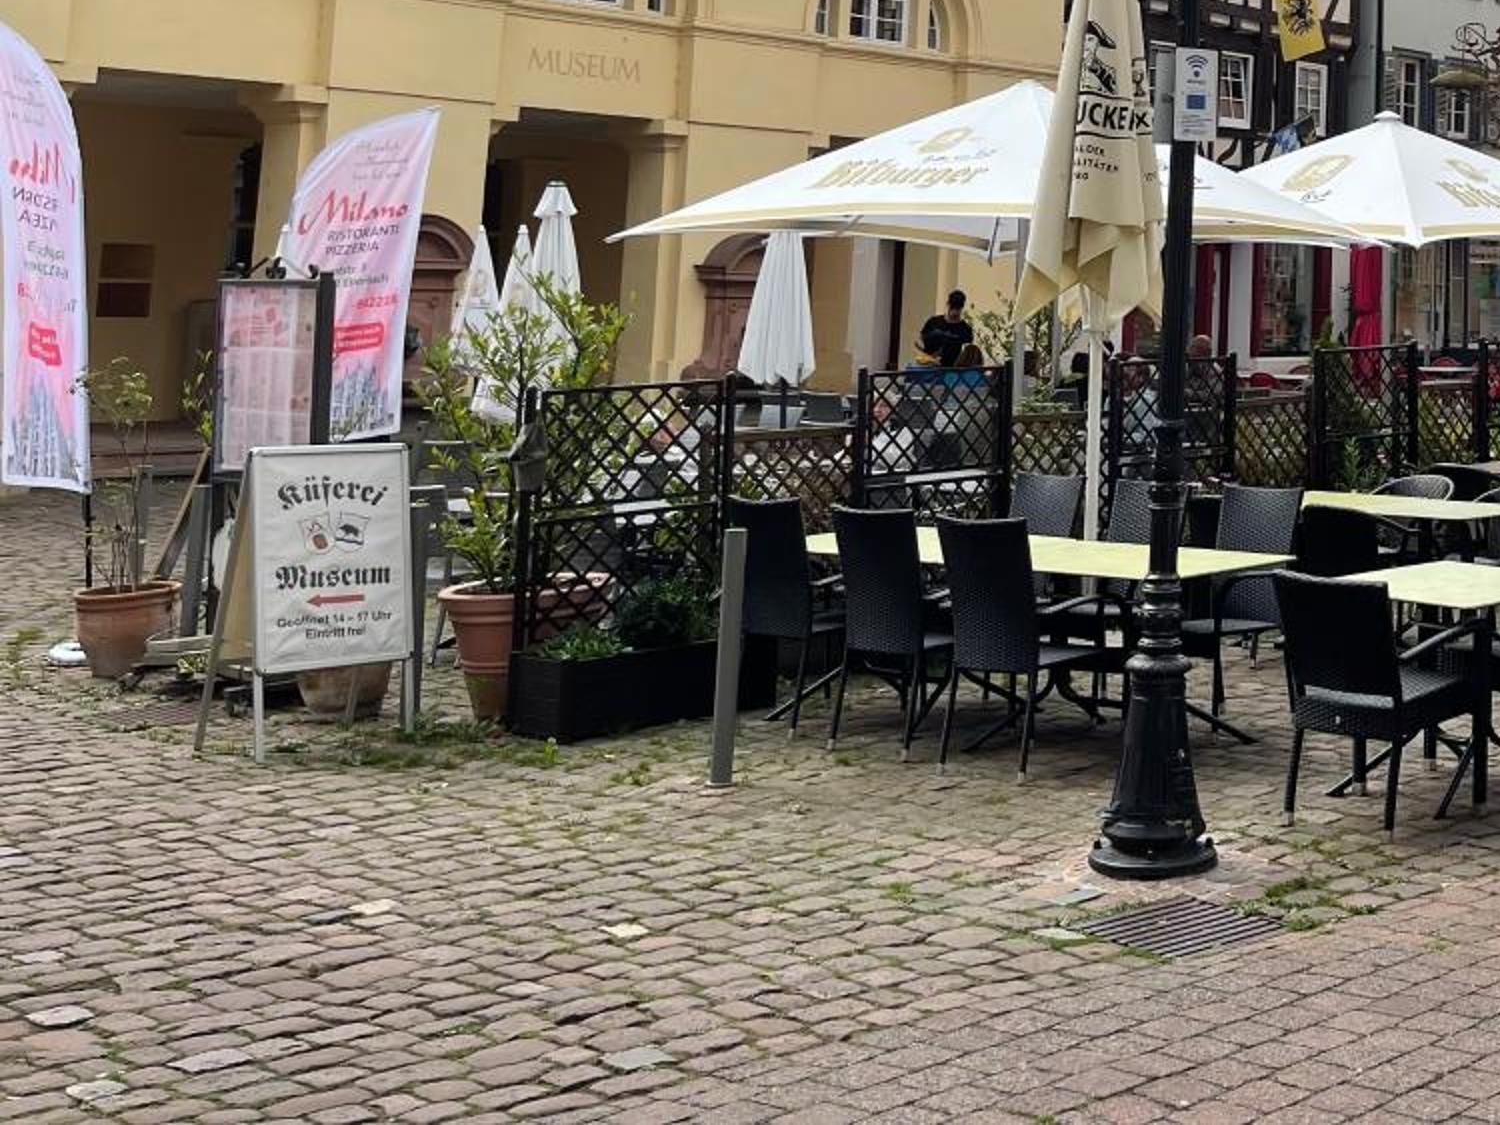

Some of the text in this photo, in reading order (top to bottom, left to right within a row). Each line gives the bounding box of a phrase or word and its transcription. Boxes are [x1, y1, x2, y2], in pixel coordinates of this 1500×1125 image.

[527, 47, 642, 83] MUSEUM
[297, 188, 409, 235] Milano
[325, 241, 379, 256] PIZZERIA
[276, 475, 389, 511] Küferei
[275, 565, 391, 591] Museum
[277, 614, 329, 628] Geöffnet
[371, 610, 393, 621] Uhr
[305, 625, 366, 640] Eintritt frei
